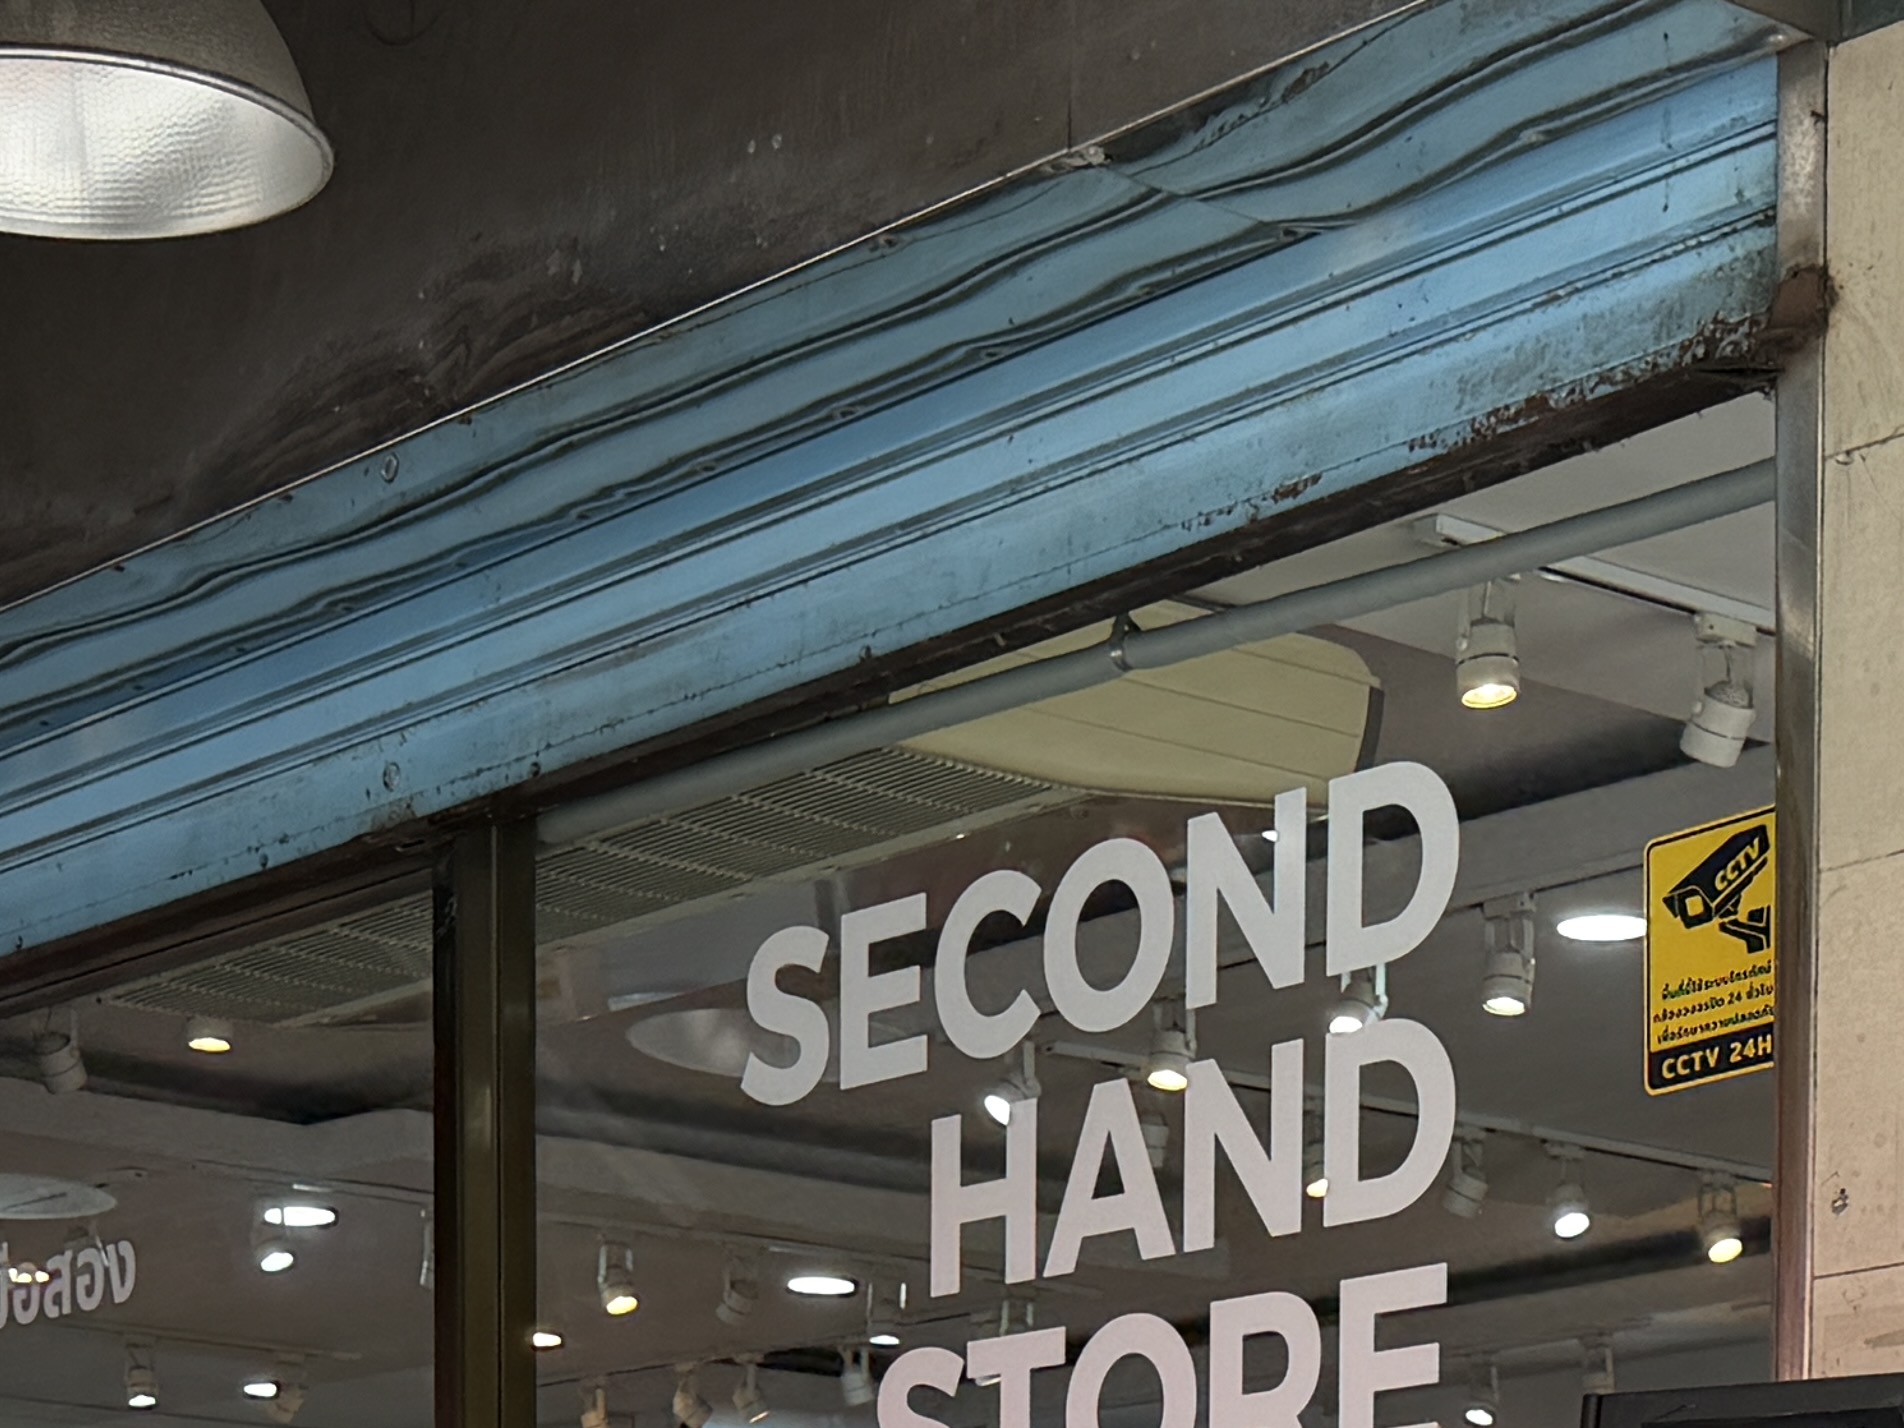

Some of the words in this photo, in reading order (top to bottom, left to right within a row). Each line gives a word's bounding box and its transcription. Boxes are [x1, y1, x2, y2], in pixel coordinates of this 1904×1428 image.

[739, 761, 1460, 1108] SECOND
[1714, 836, 1761, 892] CCTV
[1661, 1046, 1721, 1080] CCTV
[930, 1017, 1458, 1298] HAND
